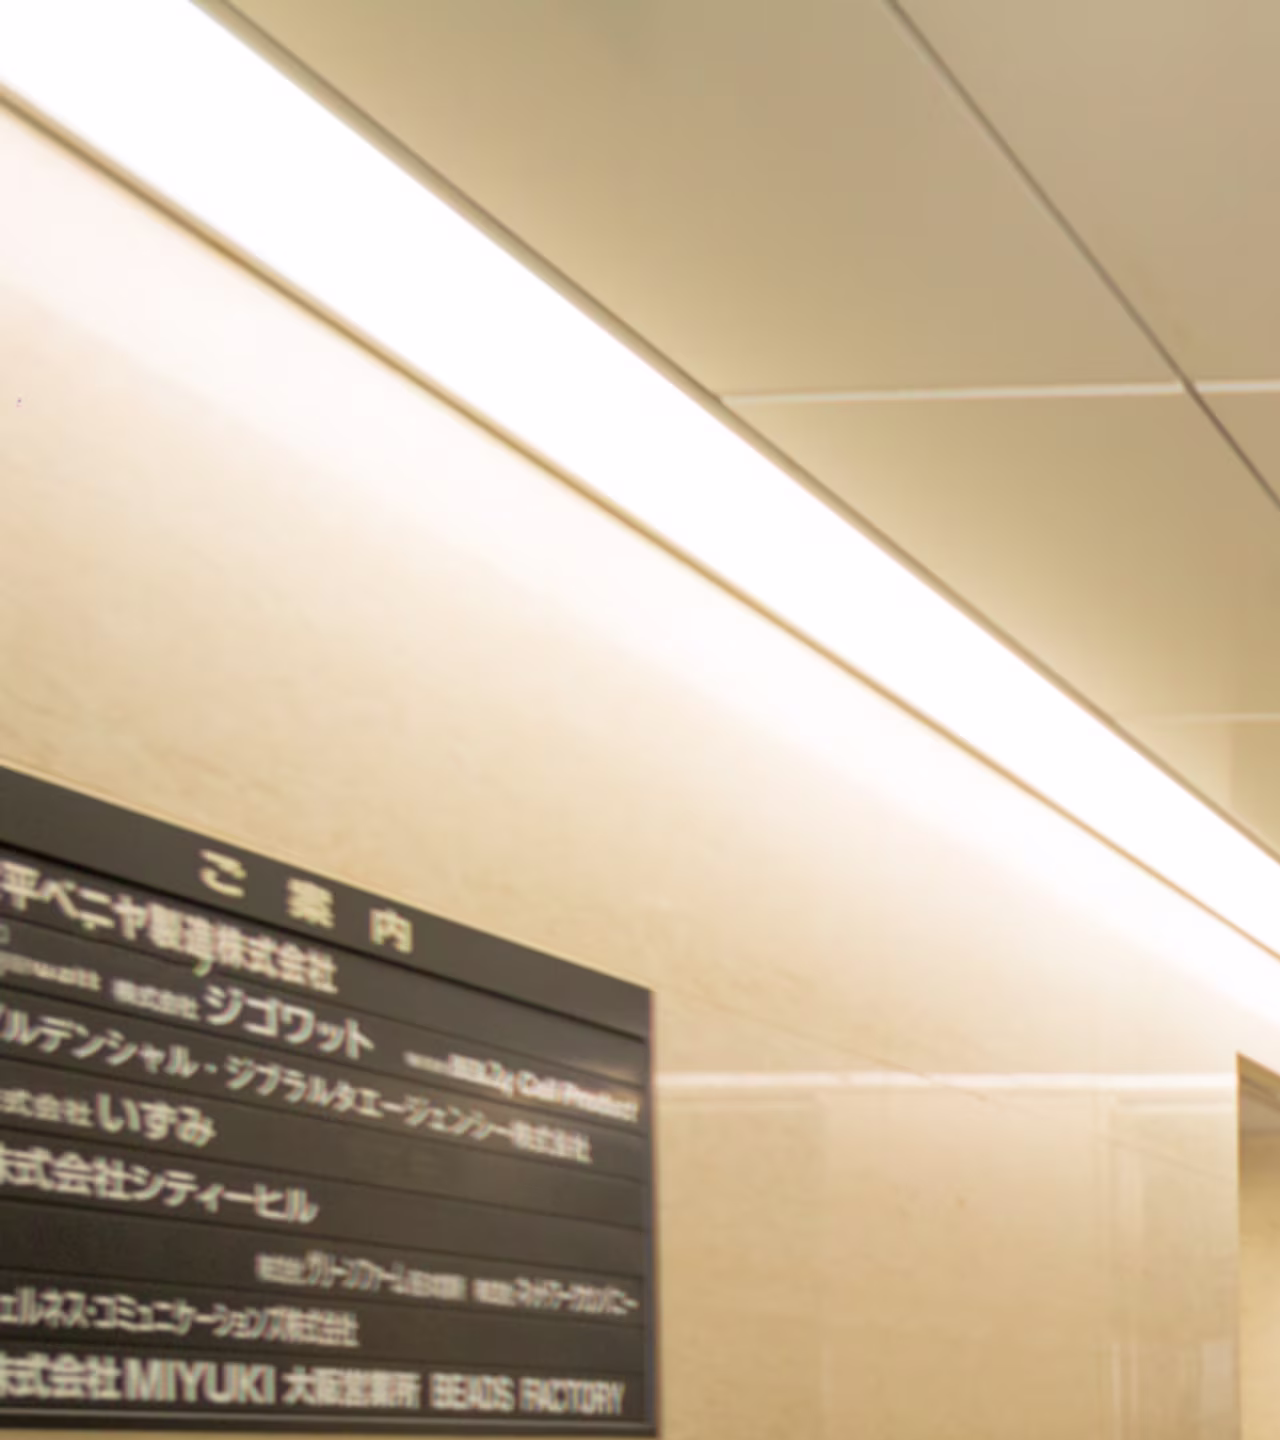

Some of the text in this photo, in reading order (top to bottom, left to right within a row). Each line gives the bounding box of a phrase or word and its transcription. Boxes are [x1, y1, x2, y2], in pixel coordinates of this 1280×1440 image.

[0, 1143, 318, 1224] 式会社シティーヒル
[0, 1351, 277, 1403] 式会社MIYUKI
[430, 1373, 514, 1412] BEADS
[519, 1378, 625, 1415] FACTORY
